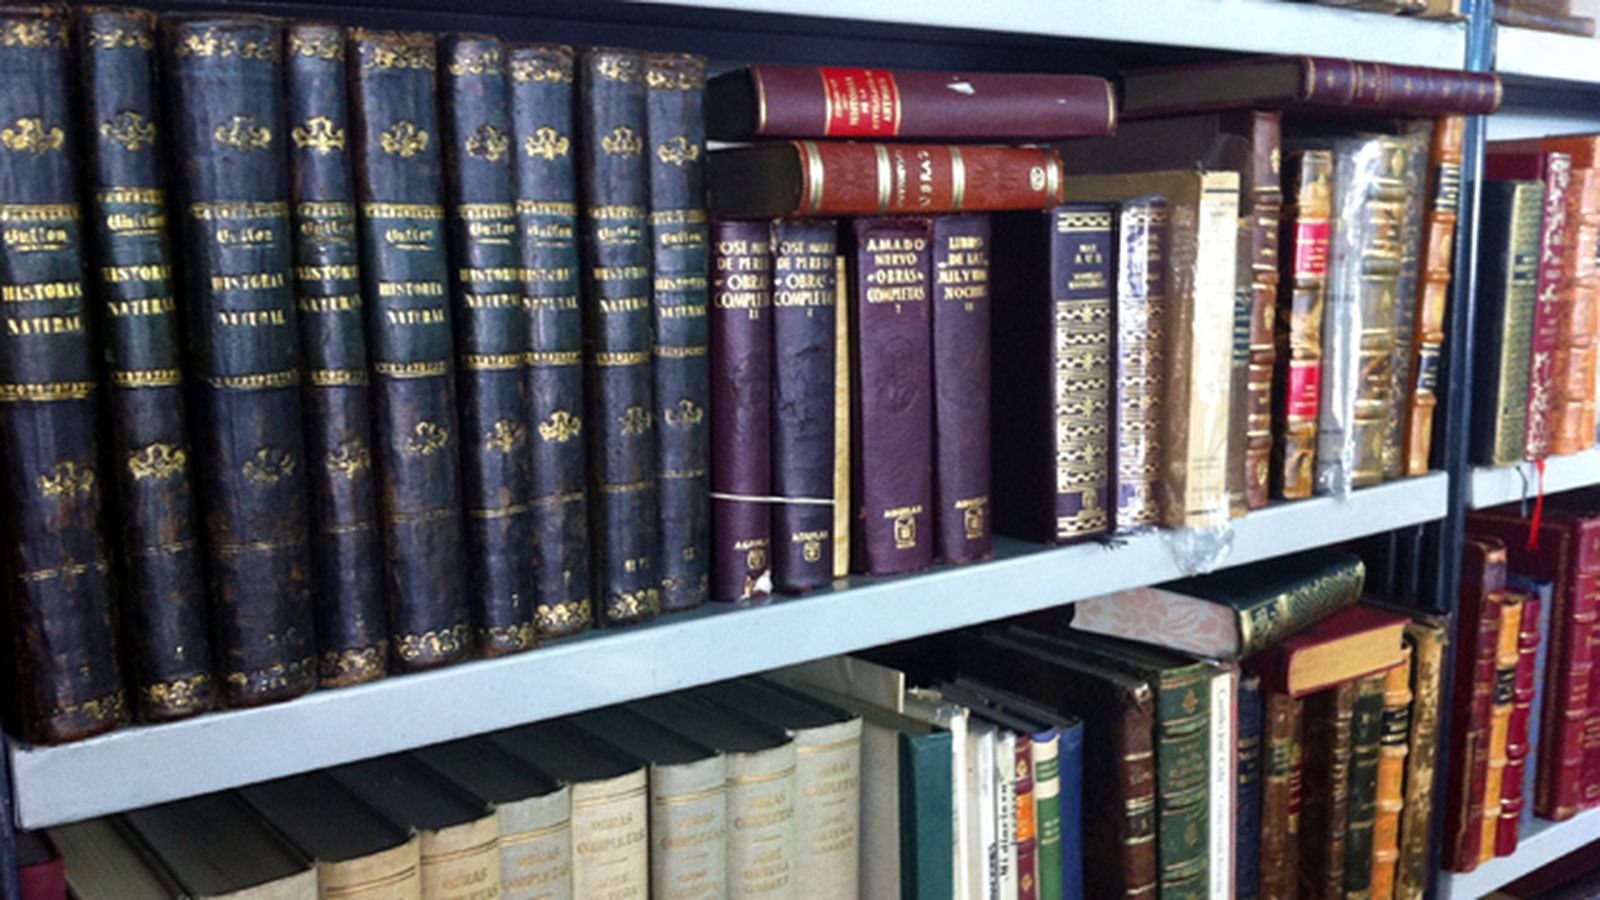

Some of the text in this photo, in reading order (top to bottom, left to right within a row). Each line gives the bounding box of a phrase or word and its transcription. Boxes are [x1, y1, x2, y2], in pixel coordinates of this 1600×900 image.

[867, 238, 926, 251] AMADO
[717, 257, 733, 270] DE
[777, 257, 791, 270] DE
[875, 253, 918, 265] NERVO
[948, 253, 963, 266] DE
[2, 282, 83, 301] HISTORIA
[867, 285, 926, 303] COMPLETAS
[734, 538, 769, 551] AGUILA
